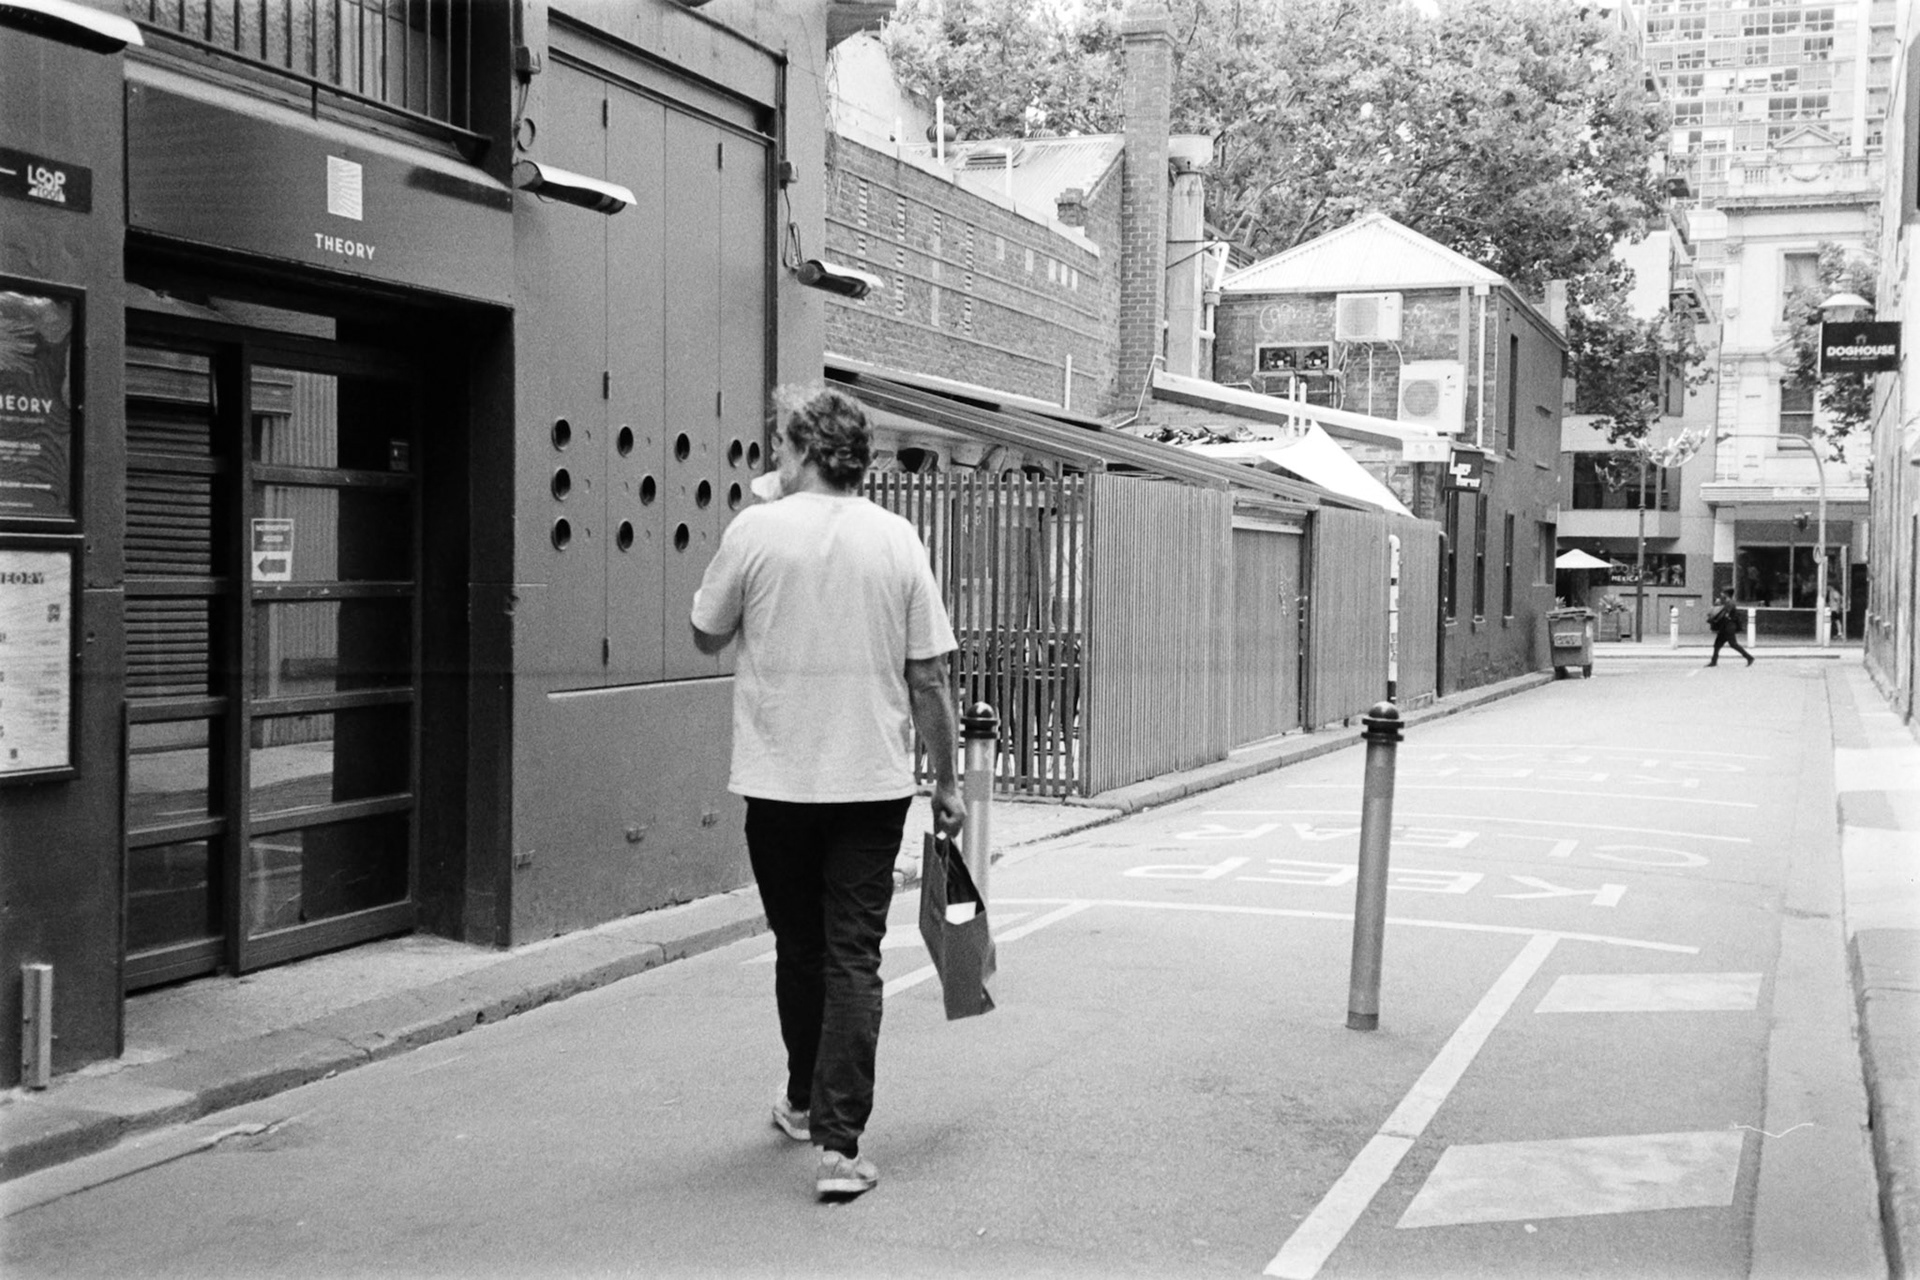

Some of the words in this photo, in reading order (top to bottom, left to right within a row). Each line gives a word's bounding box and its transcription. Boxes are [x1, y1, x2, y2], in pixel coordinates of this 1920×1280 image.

[28, 164, 66, 190] LOOP
[314, 232, 375, 260] THEORY
[1826, 345, 1895, 356] DOGHOUSE
[0, 571, 45, 585] EORY
[1174, 822, 1710, 868] CLEAR
[1122, 856, 1628, 907] KEEP
